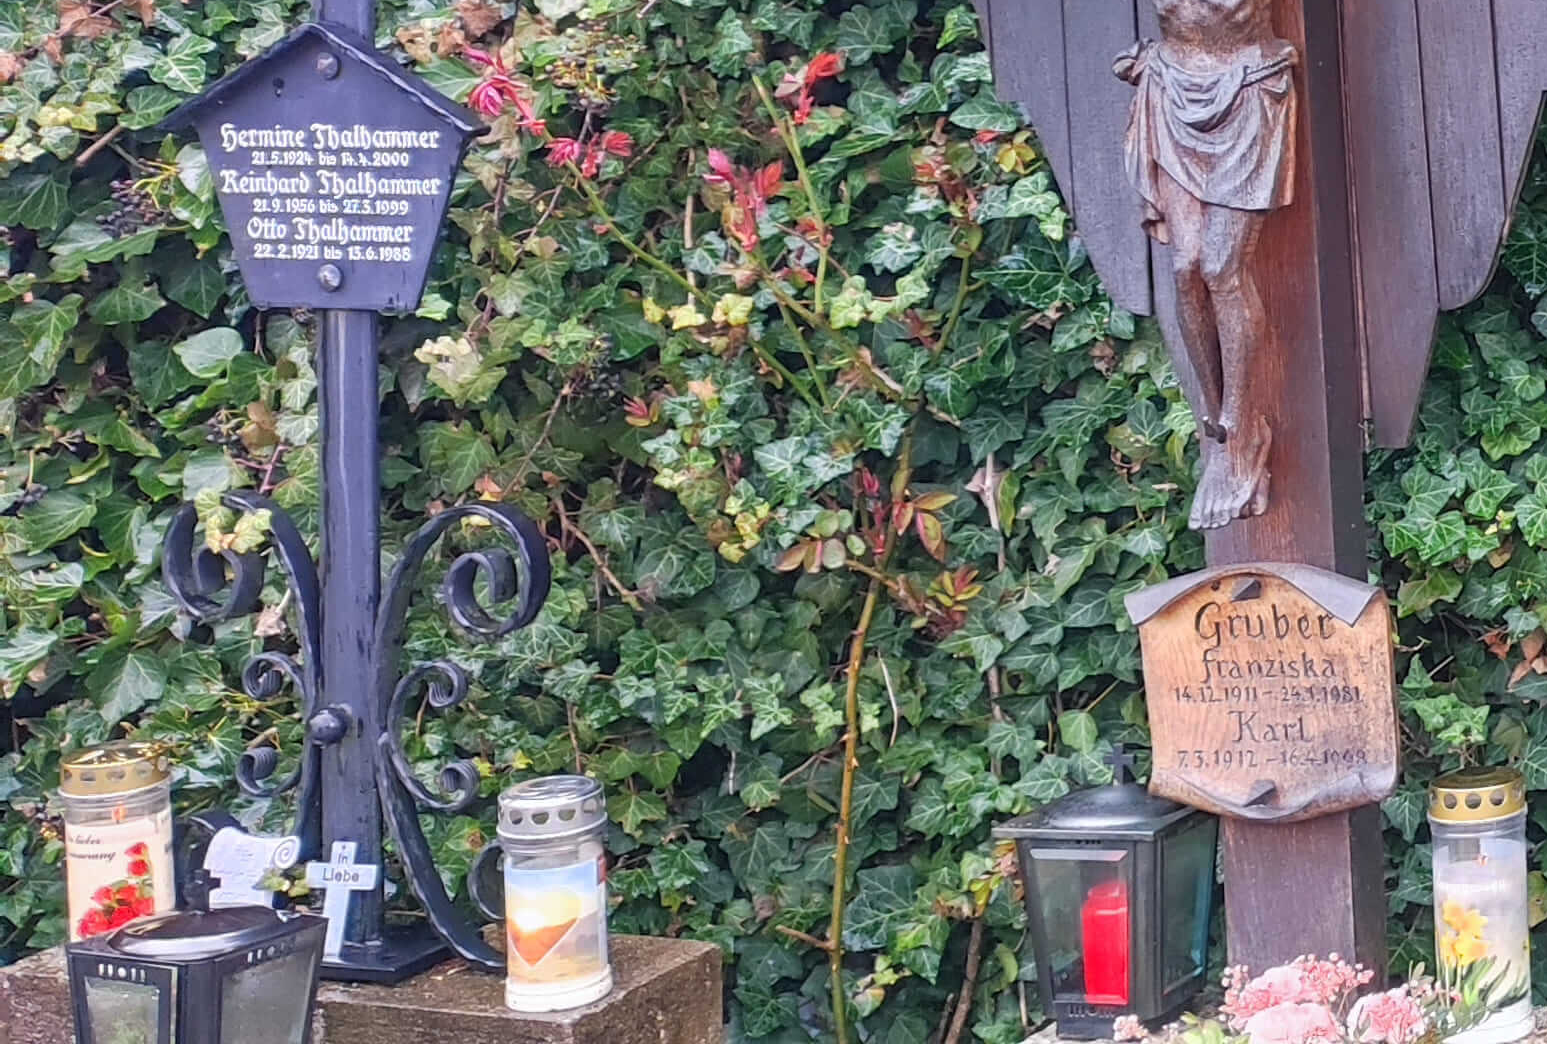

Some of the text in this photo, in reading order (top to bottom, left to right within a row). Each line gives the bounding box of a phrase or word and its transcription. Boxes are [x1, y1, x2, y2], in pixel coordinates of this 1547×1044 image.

[220, 123, 440, 152] Hermine Thalhammer
[251, 151, 313, 165] 21.5.1924
[318, 151, 336, 166] bis
[219, 169, 442, 199] Reinhard Thalhammer
[252, 198, 315, 213] 21.9.1956
[319, 198, 338, 214] bis
[247, 216, 414, 245] Otto Thalhammer
[323, 245, 343, 260] bis
[1194, 601, 1336, 648] Gruber
[1226, 709, 1314, 744] Karl
[322, 867, 360, 883] Liebe
